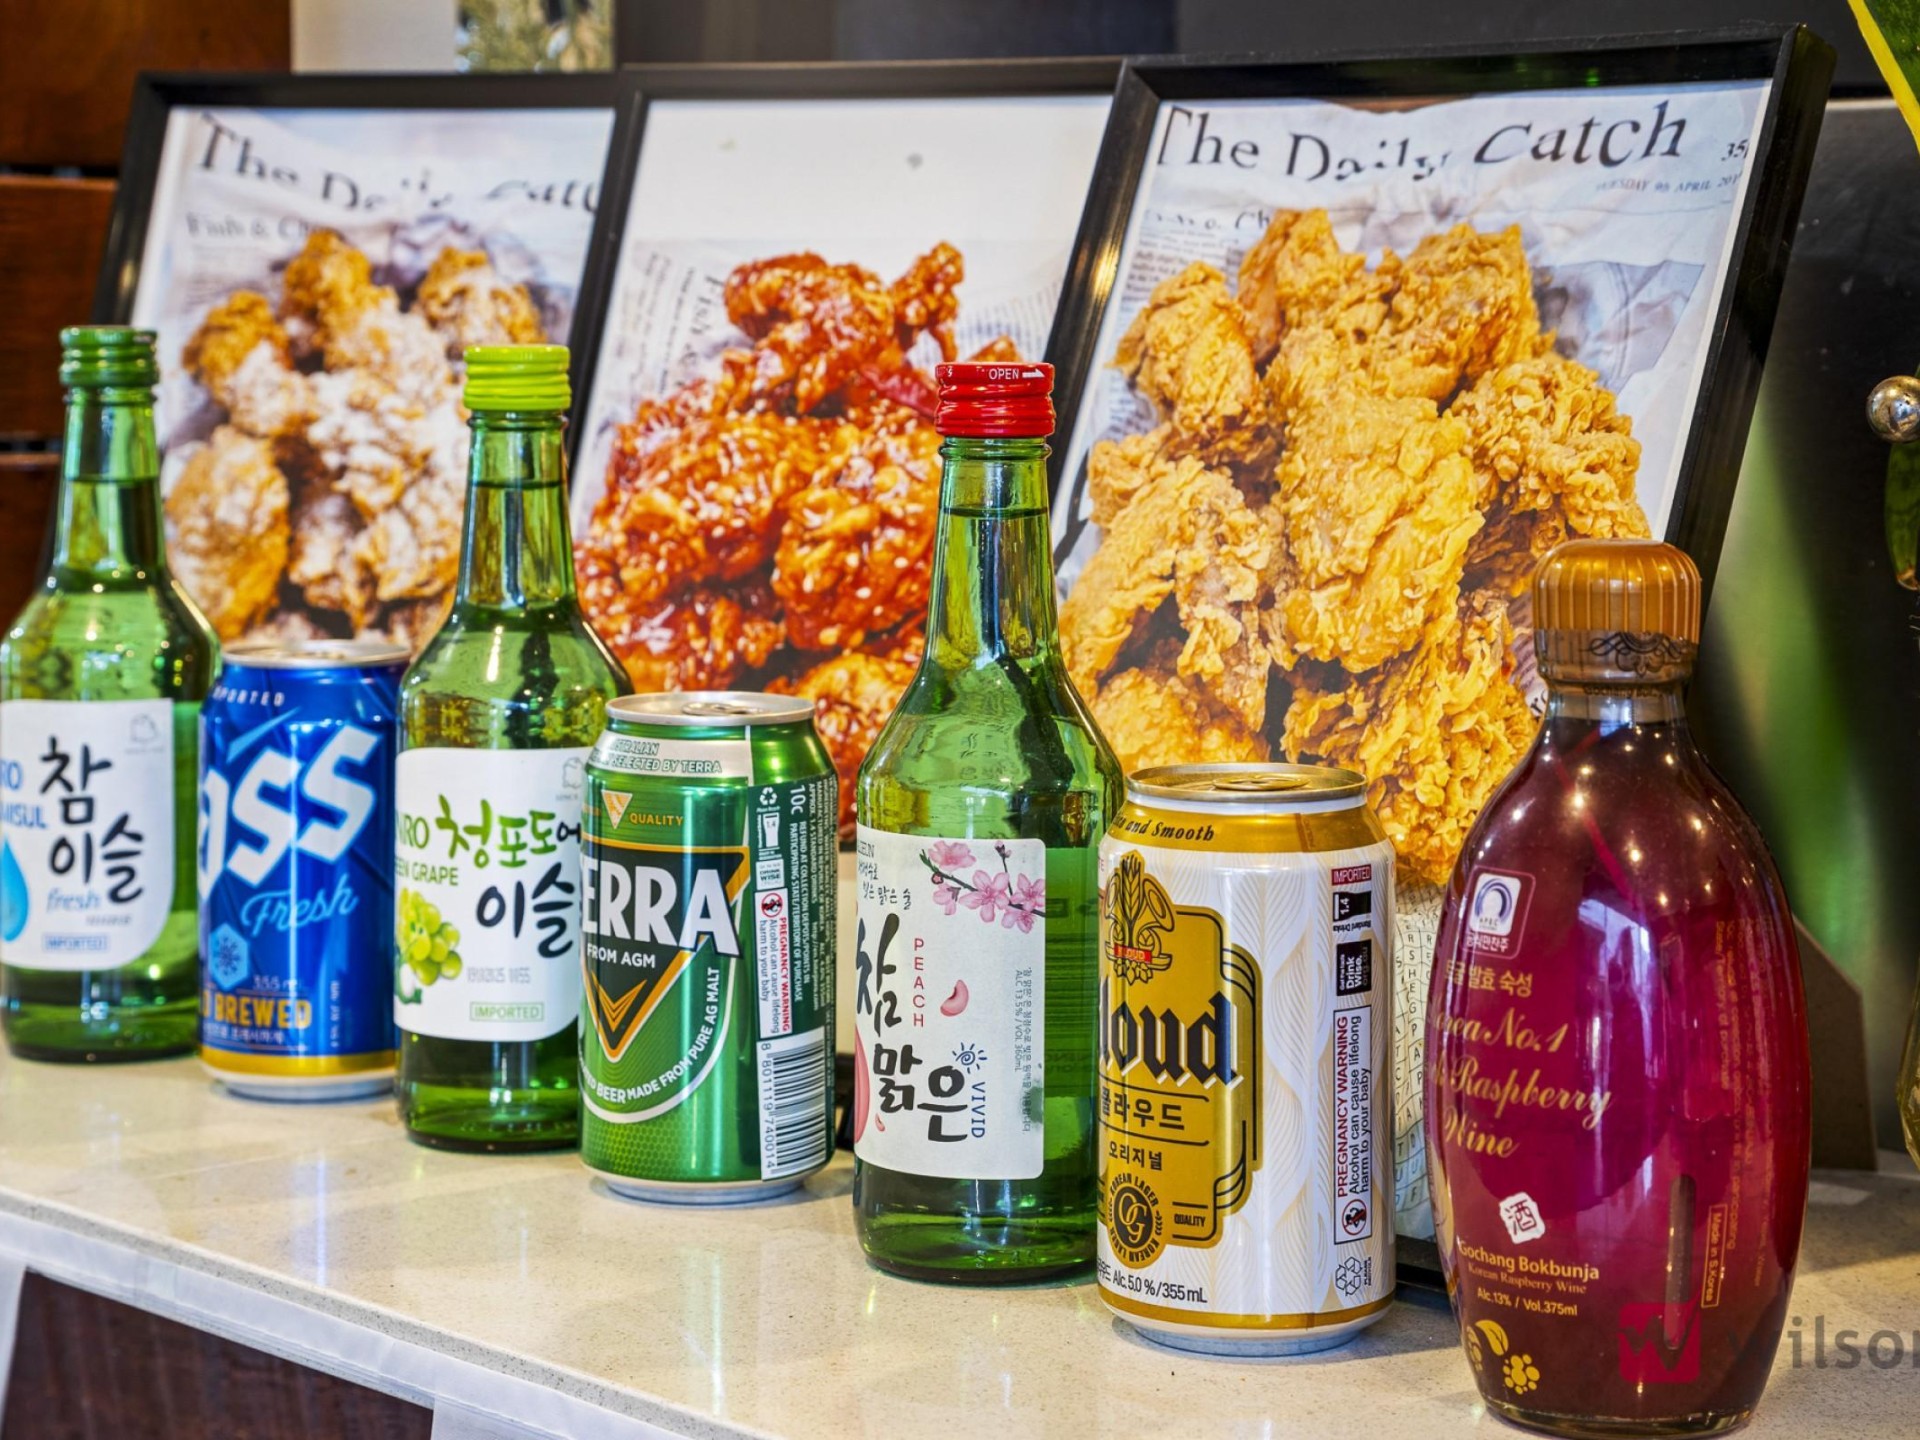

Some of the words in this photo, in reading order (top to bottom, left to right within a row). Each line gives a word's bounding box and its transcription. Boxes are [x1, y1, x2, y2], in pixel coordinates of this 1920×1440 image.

[198, 112, 297, 184] The
[1157, 104, 1260, 170] The
[1474, 99, 1687, 168] Catch
[988, 367, 1020, 380] OPEN
[40, 735, 112, 824] 참
[662, 759, 681, 772] BY
[681, 760, 722, 774] TERRA
[629, 812, 685, 827] QUALITY
[1125, 819, 1152, 834] and
[1151, 820, 1215, 842] Smooth
[790, 822, 800, 880] PARTICIPATING
[799, 821, 808, 852] REFUND
[48, 812, 144, 904] 이슬
[412, 861, 459, 887] GRAPE
[1333, 866, 1370, 883] IMPORTED
[800, 864, 810, 911] COLLECTION
[240, 872, 360, 938] Fresh
[476, 862, 575, 959] 이슬
[1339, 897, 1350, 915] 1.4
[760, 920, 769, 944] harm
[769, 919, 779, 952] Alcohol
[779, 917, 789, 979] PREGNANCY
[586, 943, 617, 965] FROM
[621, 952, 656, 969] AGM
[758, 958, 769, 978] your
[770, 954, 779, 970] can
[705, 966, 720, 1003] MALT
[771, 972, 780, 996] cause
[793, 960, 803, 1002] PURCHASE
[912, 937, 926, 1028] PEACH
[1345, 956, 1355, 990] Drink
[1499, 970, 1533, 998] 숙성
[760, 979, 770, 1002] baby
[781, 982, 791, 1032] WARNING
[474, 1005, 540, 1020] IMPORTED
[703, 1004, 719, 1026] AG
[771, 999, 782, 1034] lifelong
[687, 1023, 714, 1061] PURE
[1335, 1016, 1349, 1095] WARNING
[1347, 1015, 1362, 1066] lifelong
[659, 1055, 693, 1088] FROM
[1358, 1067, 1371, 1102] baby
[596, 1082, 627, 1105] BEER
[626, 1079, 661, 1101] MADE
[1349, 1068, 1360, 1111] cause
[1450, 1054, 1612, 1130] Raspberry
[970, 1081, 986, 1139] VIVID
[1360, 1105, 1372, 1135] your
[1350, 1114, 1361, 1140] can
[1445, 1106, 1520, 1159] Wine
[1109, 1141, 1163, 1172] 오리지널
[1336, 1097, 1349, 1198] PREGNANCY
[1360, 1139, 1370, 1154] to
[1348, 1143, 1361, 1195] Alcohol
[1359, 1156, 1370, 1193] harm
[1135, 1176, 1160, 1207] LAGER
[1174, 1213, 1207, 1228] QUALITY
[1507, 1202, 1538, 1237] 酒
[1711, 1212, 1723, 1244] Made
[1458, 1239, 1515, 1273] Gochang
[1518, 1255, 1600, 1283] Bokbunja
[1710, 1247, 1719, 1257] in
[1113, 1269, 1128, 1290] Alc.
[1128, 1274, 1143, 1294] 5.0
[1187, 1286, 1209, 1304] mL
[1468, 1262, 1499, 1279] Korean
[1501, 1271, 1553, 1293] Raspberry
[1556, 1280, 1588, 1294] Wine
[1705, 1259, 1720, 1302] S.Korea
[1477, 1286, 1512, 1307] Alc.13%
[1523, 1298, 1578, 1317] Vol.375ml
